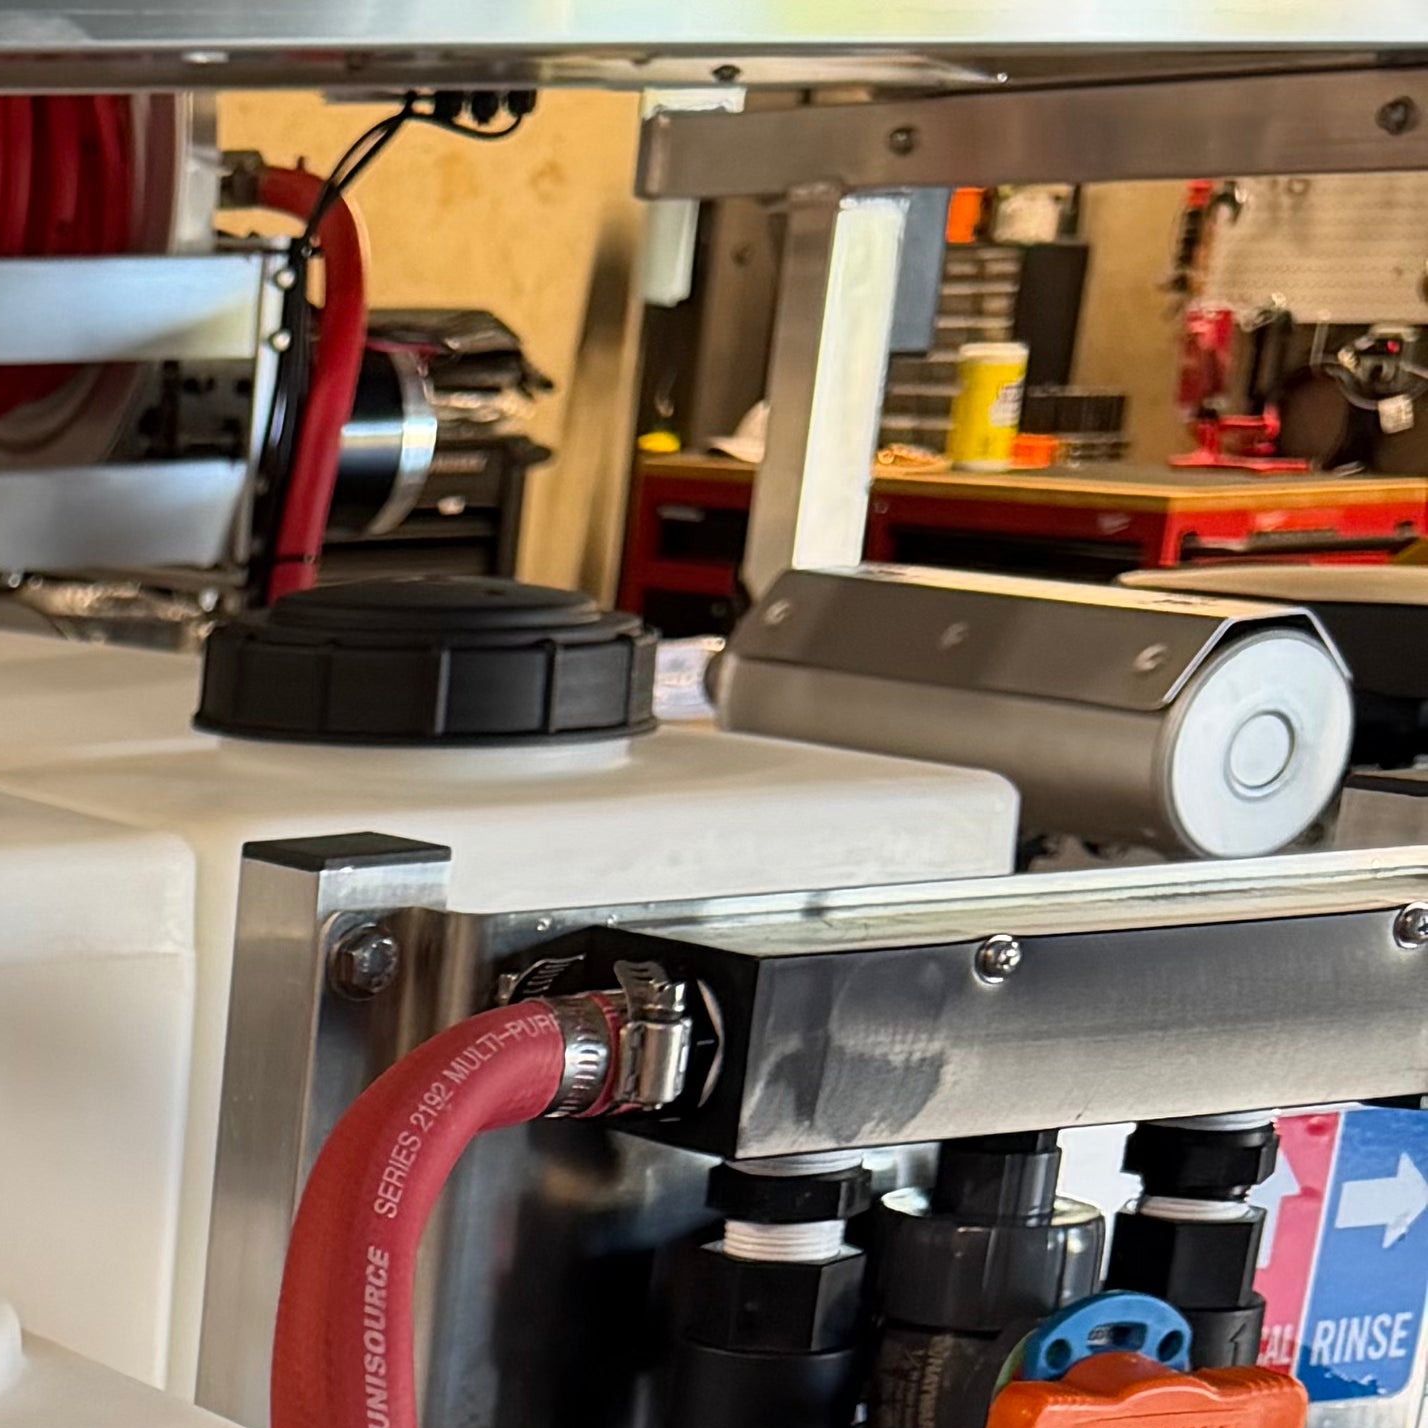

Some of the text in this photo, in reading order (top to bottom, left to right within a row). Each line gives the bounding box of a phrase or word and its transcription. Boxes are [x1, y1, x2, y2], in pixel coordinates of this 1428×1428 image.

[374, 1130, 423, 1219] SERIES
[409, 1081, 455, 1133] 2192
[1309, 1311, 1414, 1367] RINSE
